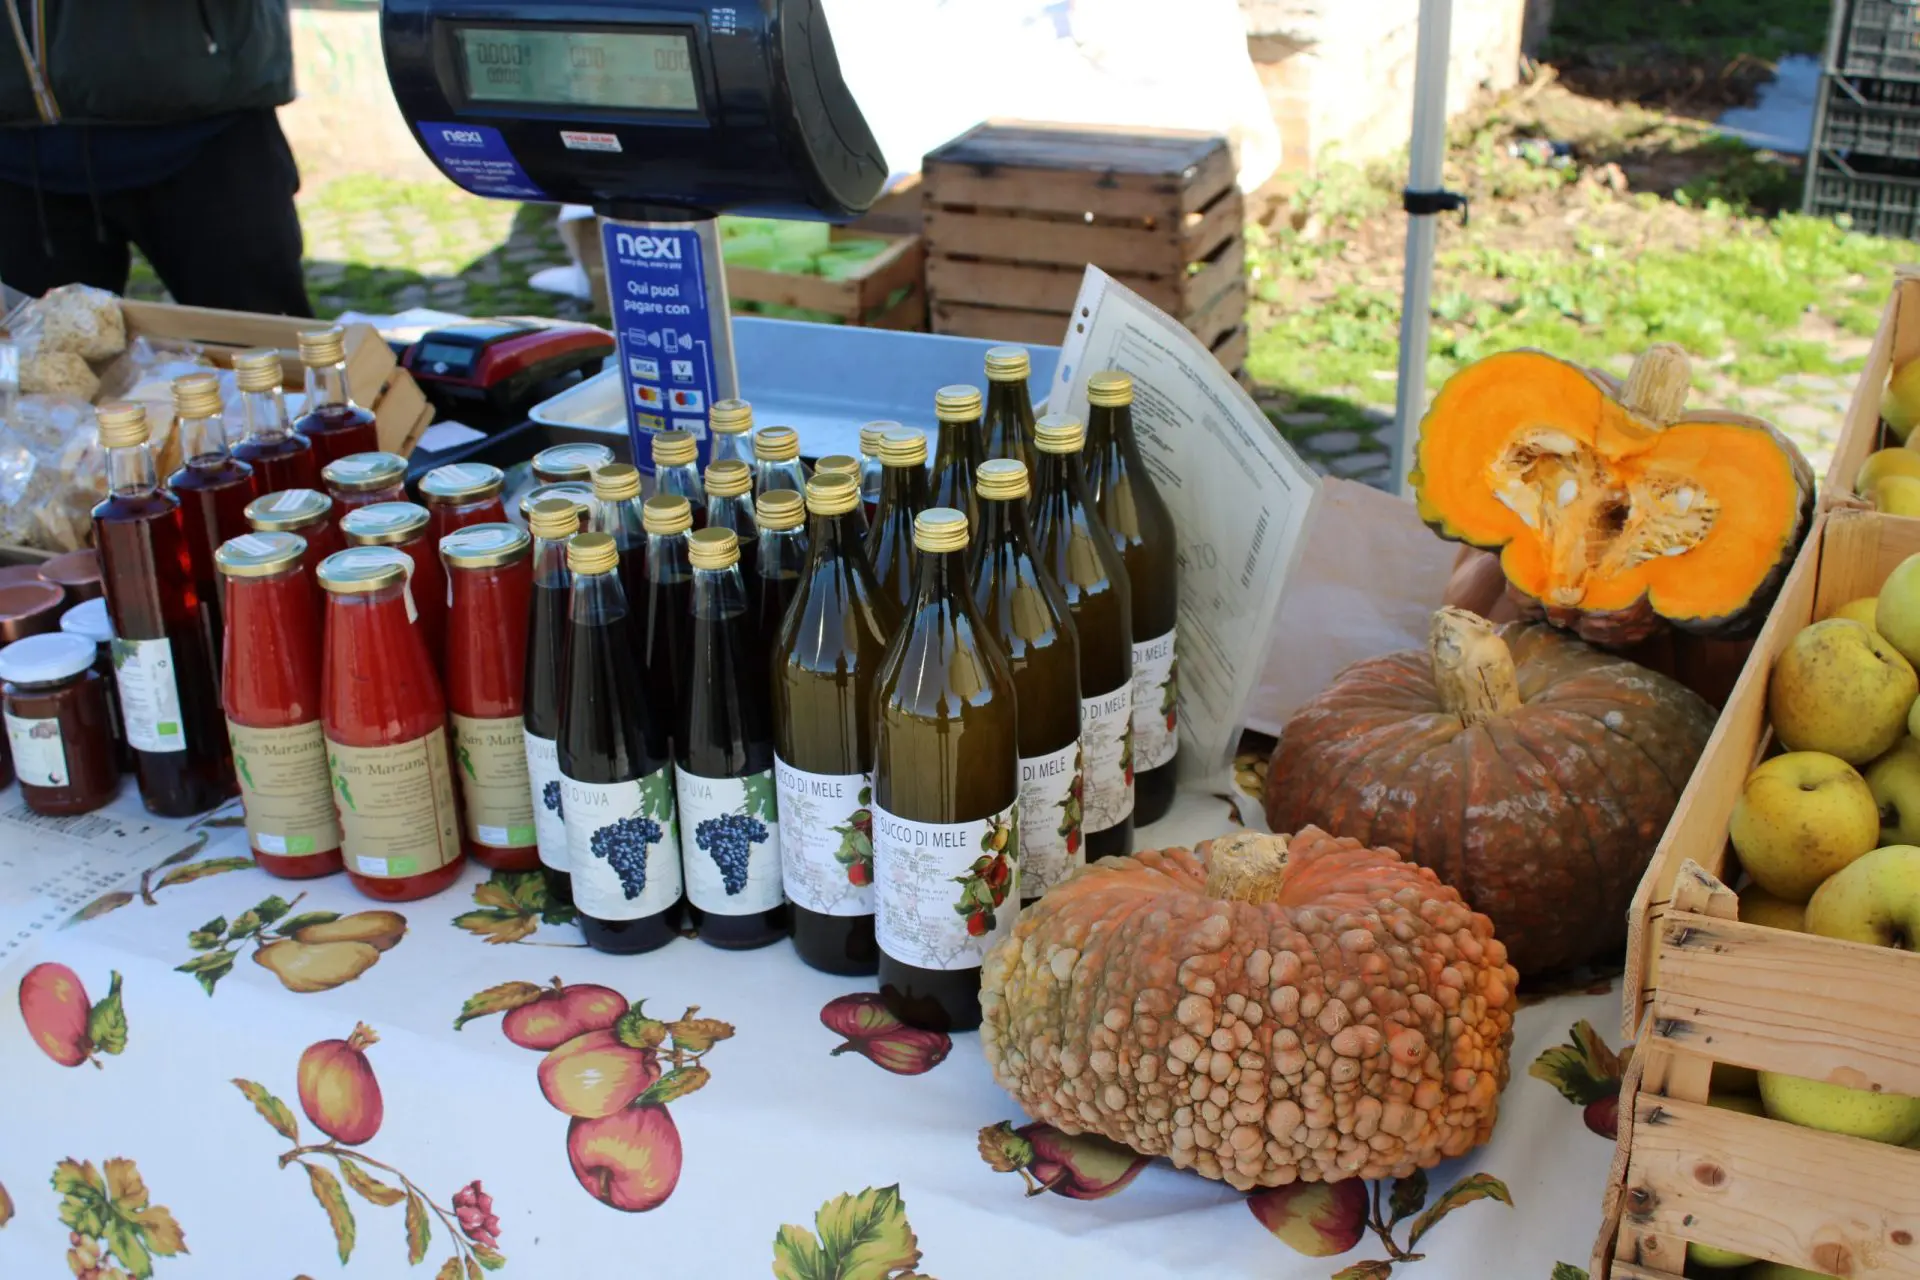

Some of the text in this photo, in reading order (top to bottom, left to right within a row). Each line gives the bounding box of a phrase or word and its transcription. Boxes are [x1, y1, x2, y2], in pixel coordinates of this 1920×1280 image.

[442, 130, 482, 143] nexi
[616, 233, 682, 260] nexi
[627, 280, 680, 298] Qui puoi
[623, 299, 690, 315] pagare con
[1145, 641, 1168, 660] MELE
[1090, 704, 1102, 719] DI
[1104, 693, 1126, 714] MELE
[462, 734, 483, 746] San
[1023, 756, 1066, 781] DI MELE
[797, 777, 808, 794] DI
[811, 781, 844, 799] MELE
[880, 816, 967, 848] SUCCO DI MELE
